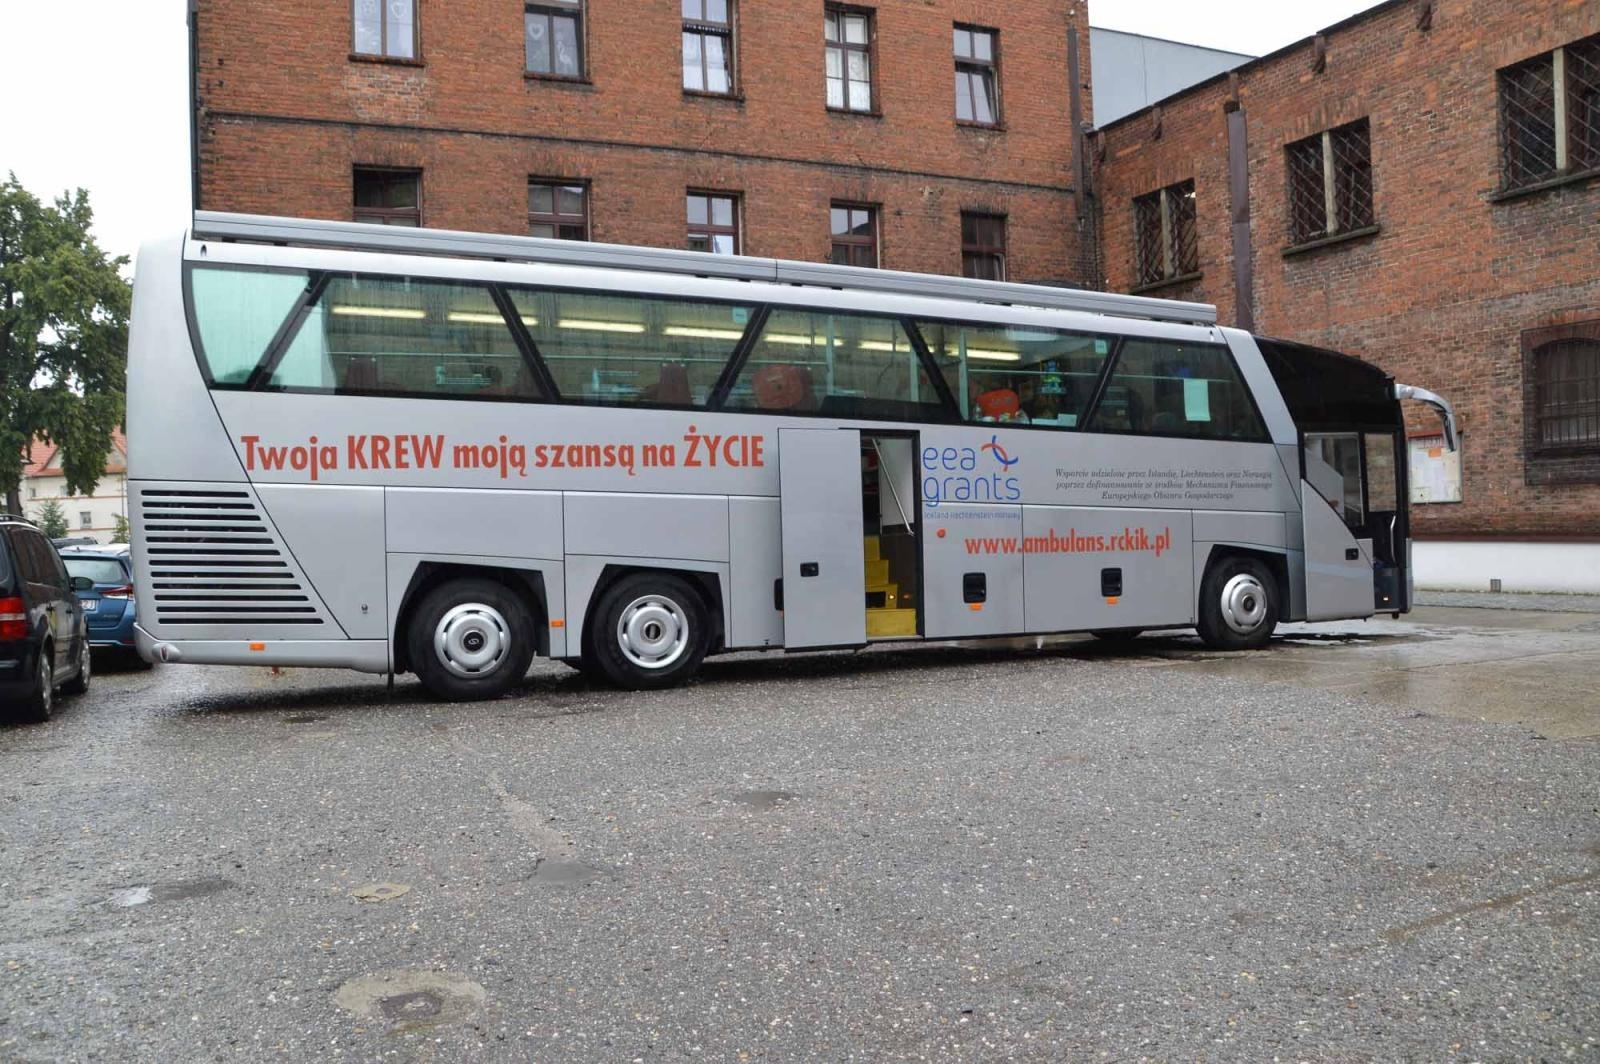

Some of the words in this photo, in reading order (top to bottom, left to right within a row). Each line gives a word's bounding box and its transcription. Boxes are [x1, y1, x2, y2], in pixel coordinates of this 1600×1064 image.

[241, 435, 338, 480] Twoja
[347, 435, 444, 469] KREW
[453, 435, 527, 478] moją
[535, 444, 636, 476] szansą
[642, 444, 675, 467] na
[683, 425, 764, 467] ŻYCIE
[923, 447, 976, 471] eea
[1055, 481, 1085, 490] poprzez
[1127, 470, 1146, 479] przez
[924, 473, 1021, 507] grants
[965, 527, 1170, 557] www.ambulans.rckik.pl
